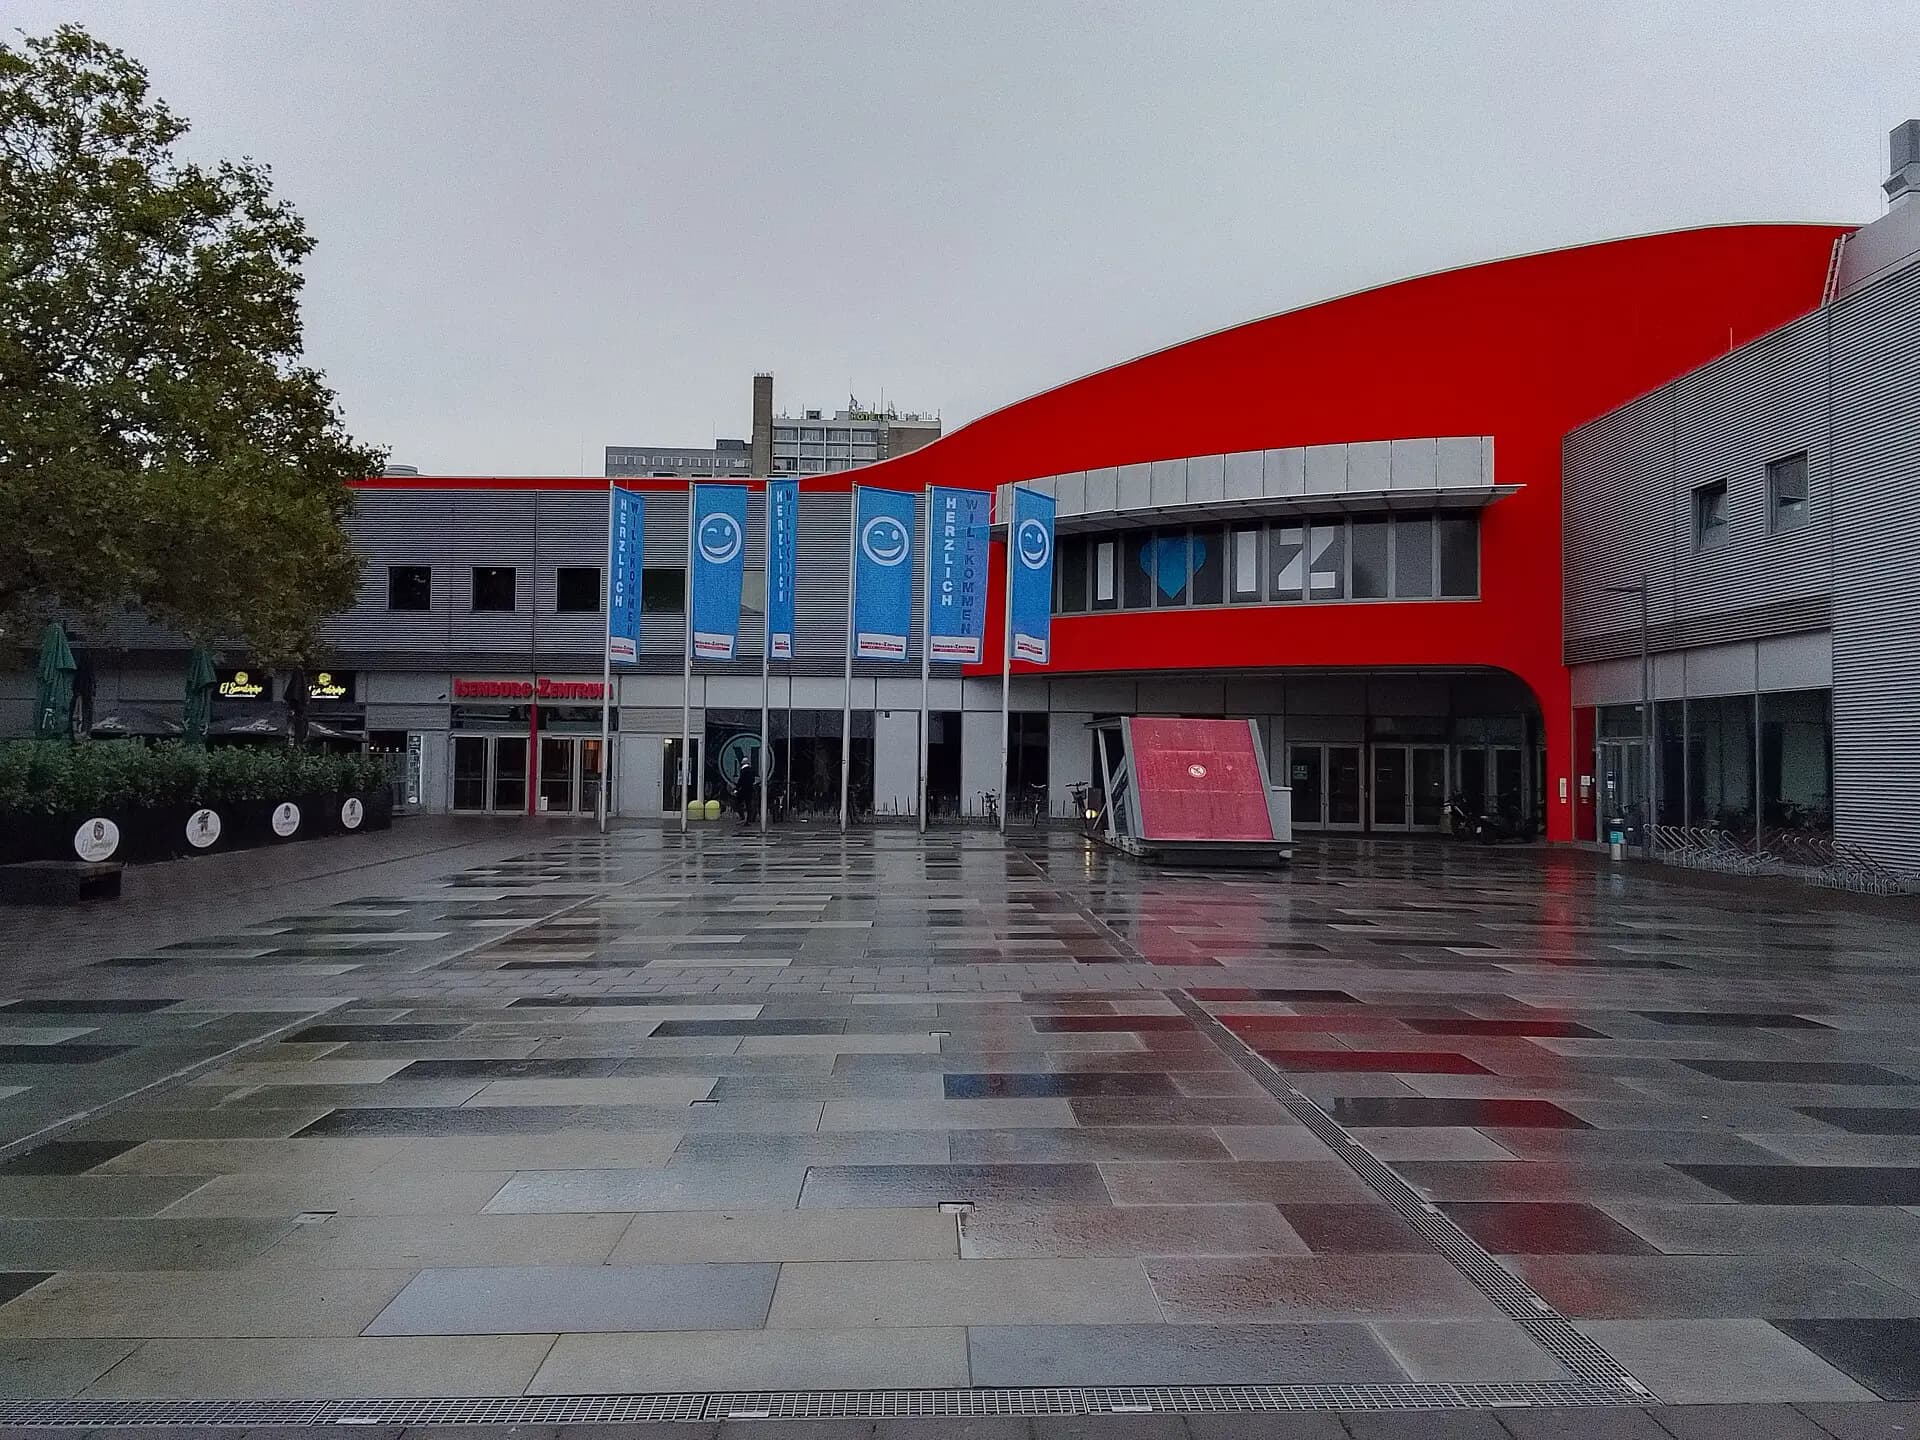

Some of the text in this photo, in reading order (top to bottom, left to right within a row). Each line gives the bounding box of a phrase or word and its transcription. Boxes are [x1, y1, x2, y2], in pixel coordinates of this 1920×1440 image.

[615, 499, 627, 608] HERZLICH
[627, 501, 640, 636] WILLKOMMEN
[942, 497, 956, 606] HERZLICH
[961, 498, 978, 635] WILLKOMMEN
[1237, 527, 1336, 592] IZ
[219, 682, 229, 694] El
